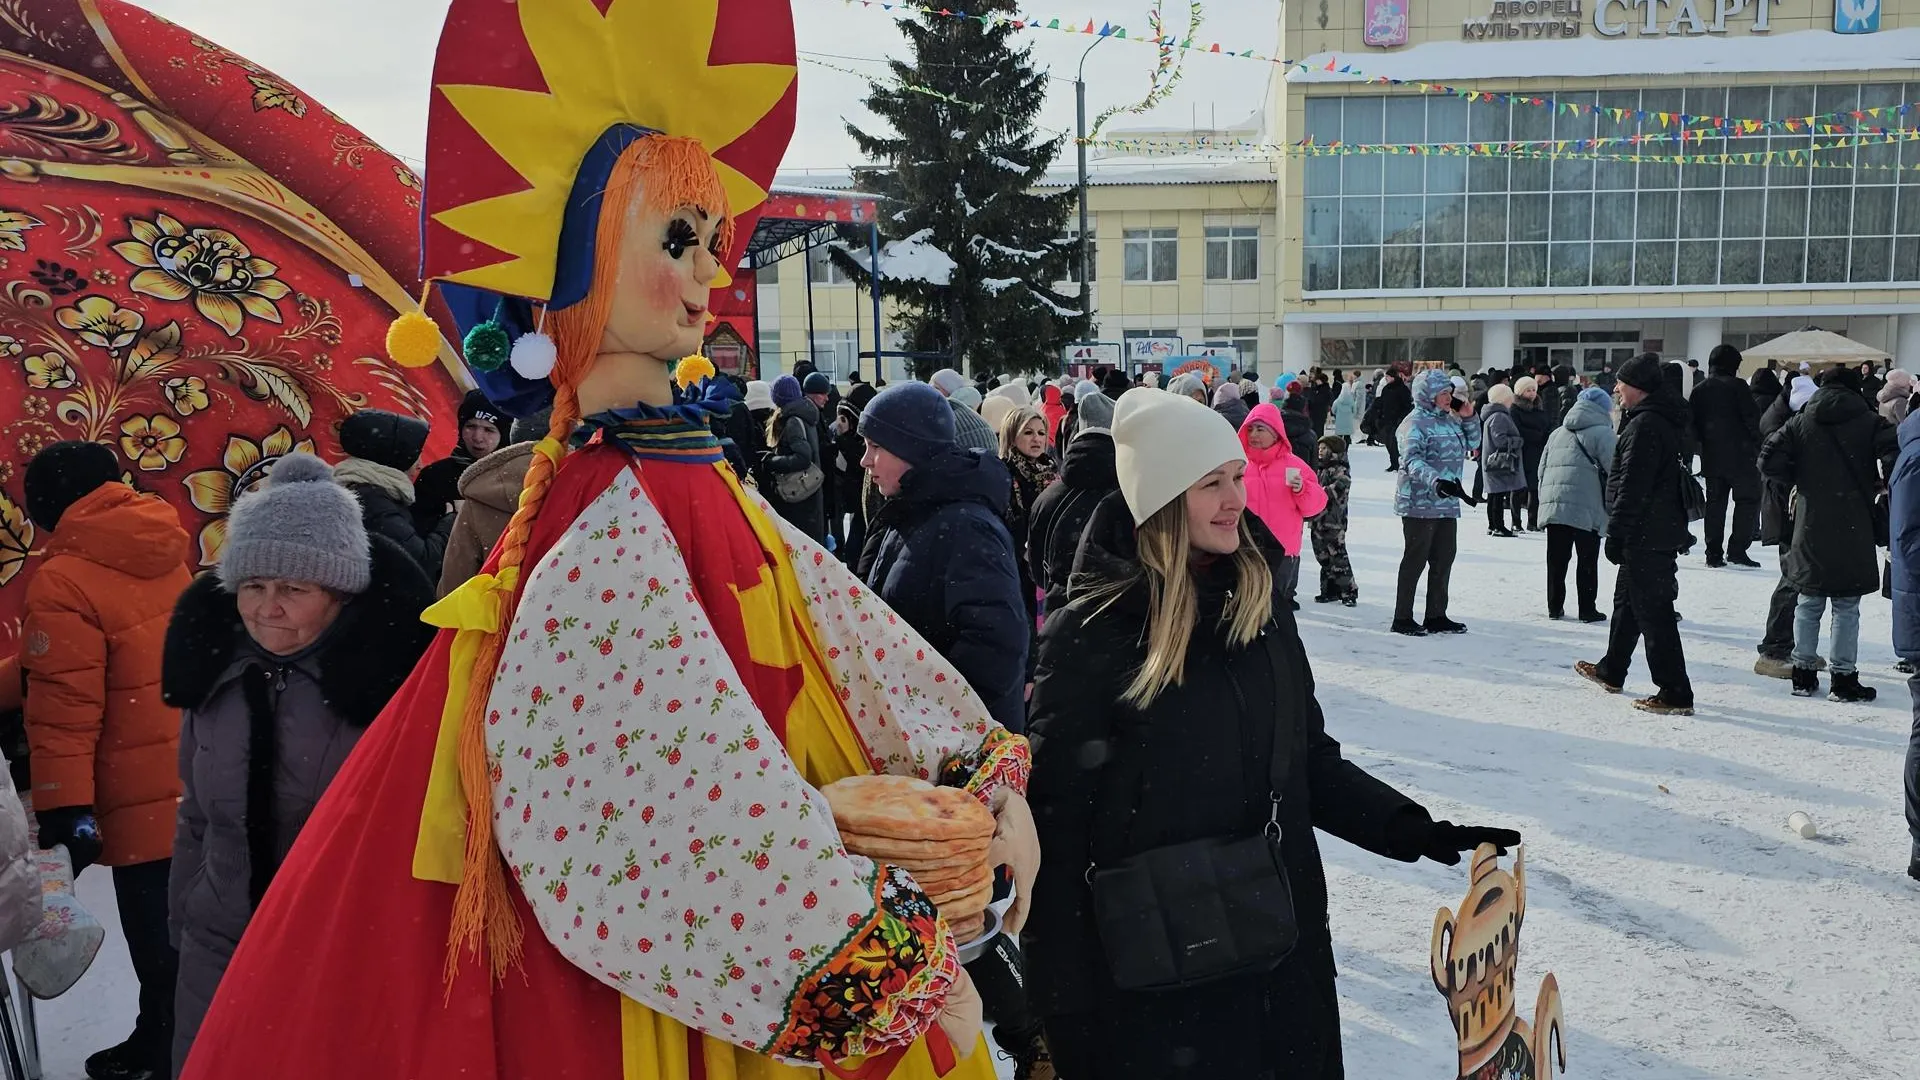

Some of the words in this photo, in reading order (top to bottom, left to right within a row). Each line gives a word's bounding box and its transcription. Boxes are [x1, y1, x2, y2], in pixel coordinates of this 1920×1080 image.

[1490, 0, 1582, 20] ДВОРЕЦ
[1593, 0, 1781, 36] СТАРТ
[1462, 21, 1581, 39] КУЛЬТУРЫ
[475, 410, 498, 423] UFC
[996, 944, 1021, 979] AMG
